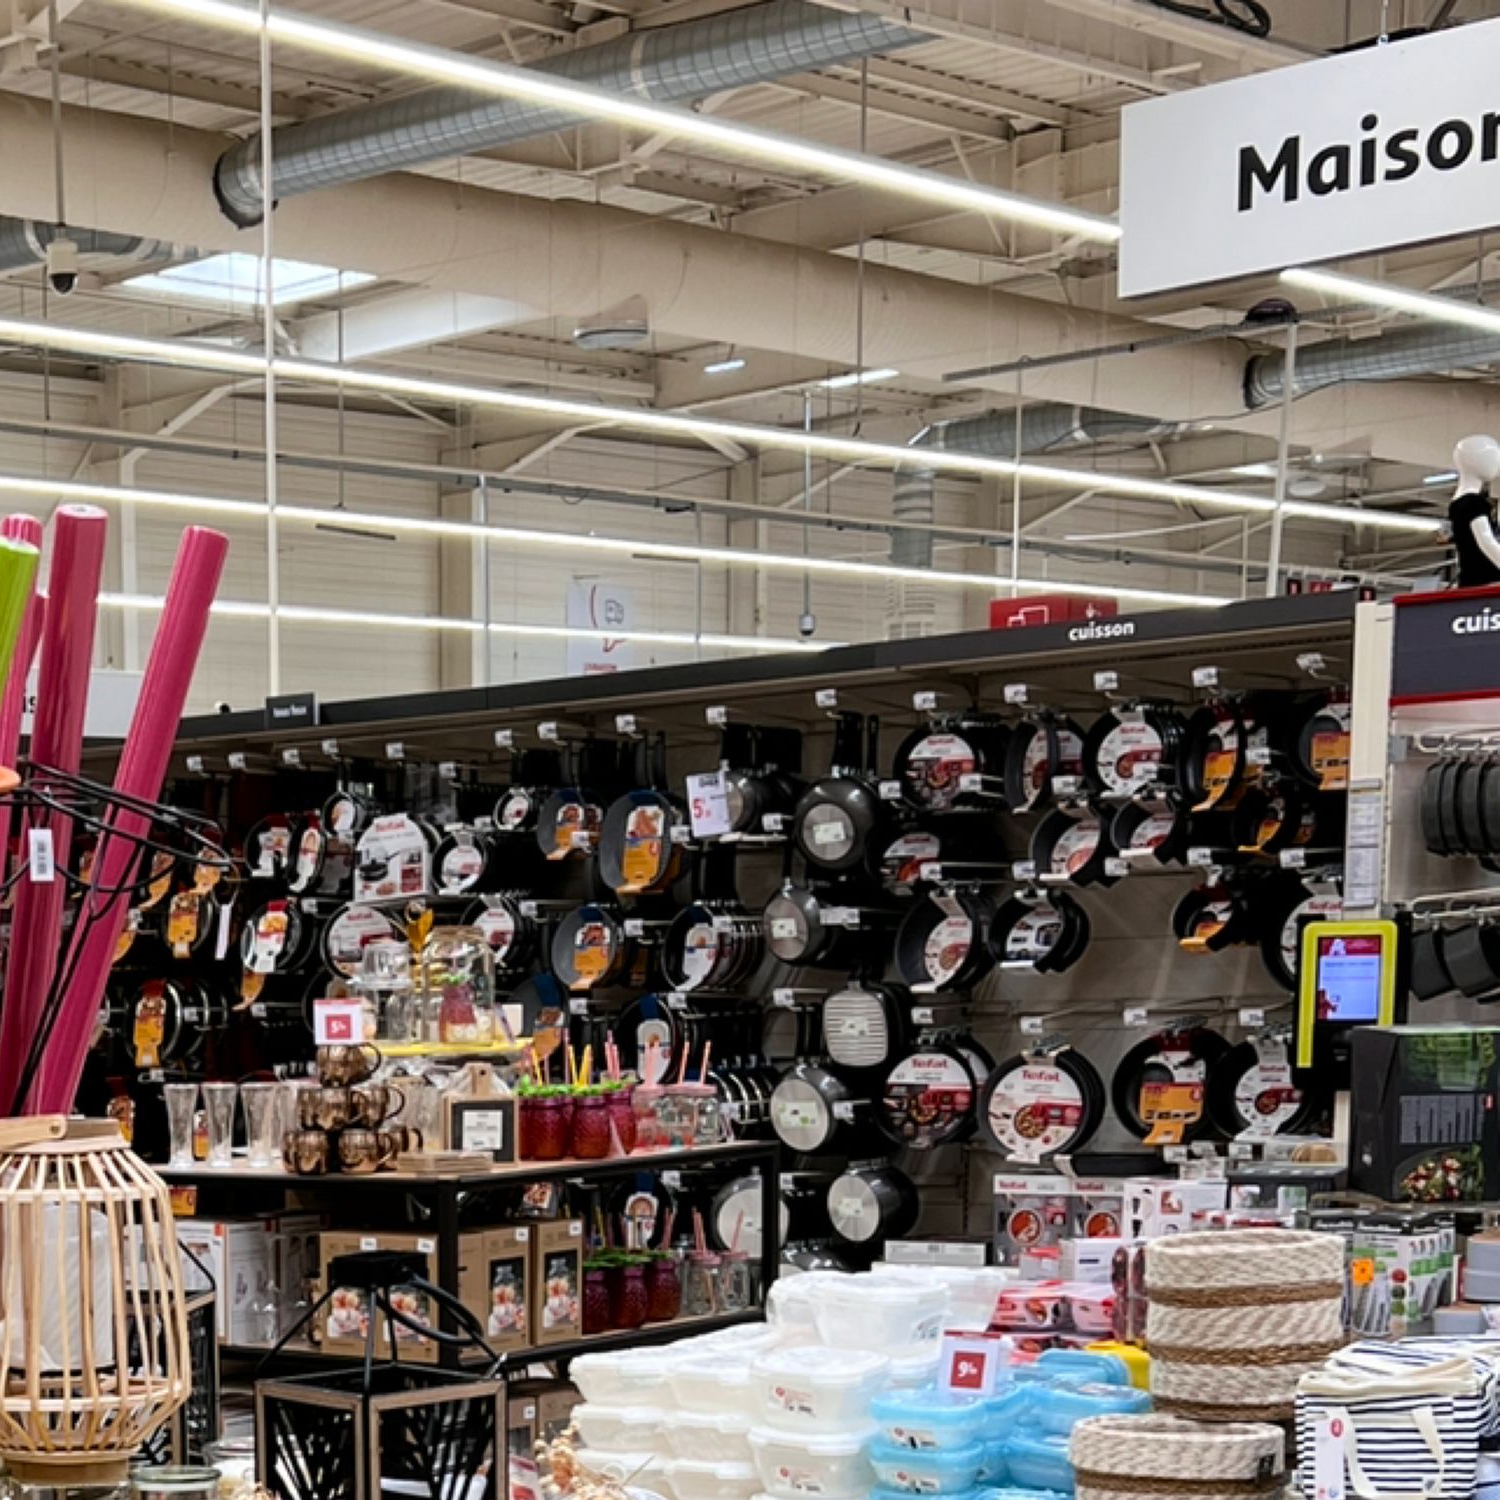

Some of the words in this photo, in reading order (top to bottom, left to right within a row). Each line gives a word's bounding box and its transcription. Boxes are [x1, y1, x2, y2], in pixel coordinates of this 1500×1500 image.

[1069, 620, 1134, 641] cuisson
[911, 1058, 949, 1069] Tefal
[1022, 1069, 1060, 1082] Tefal
